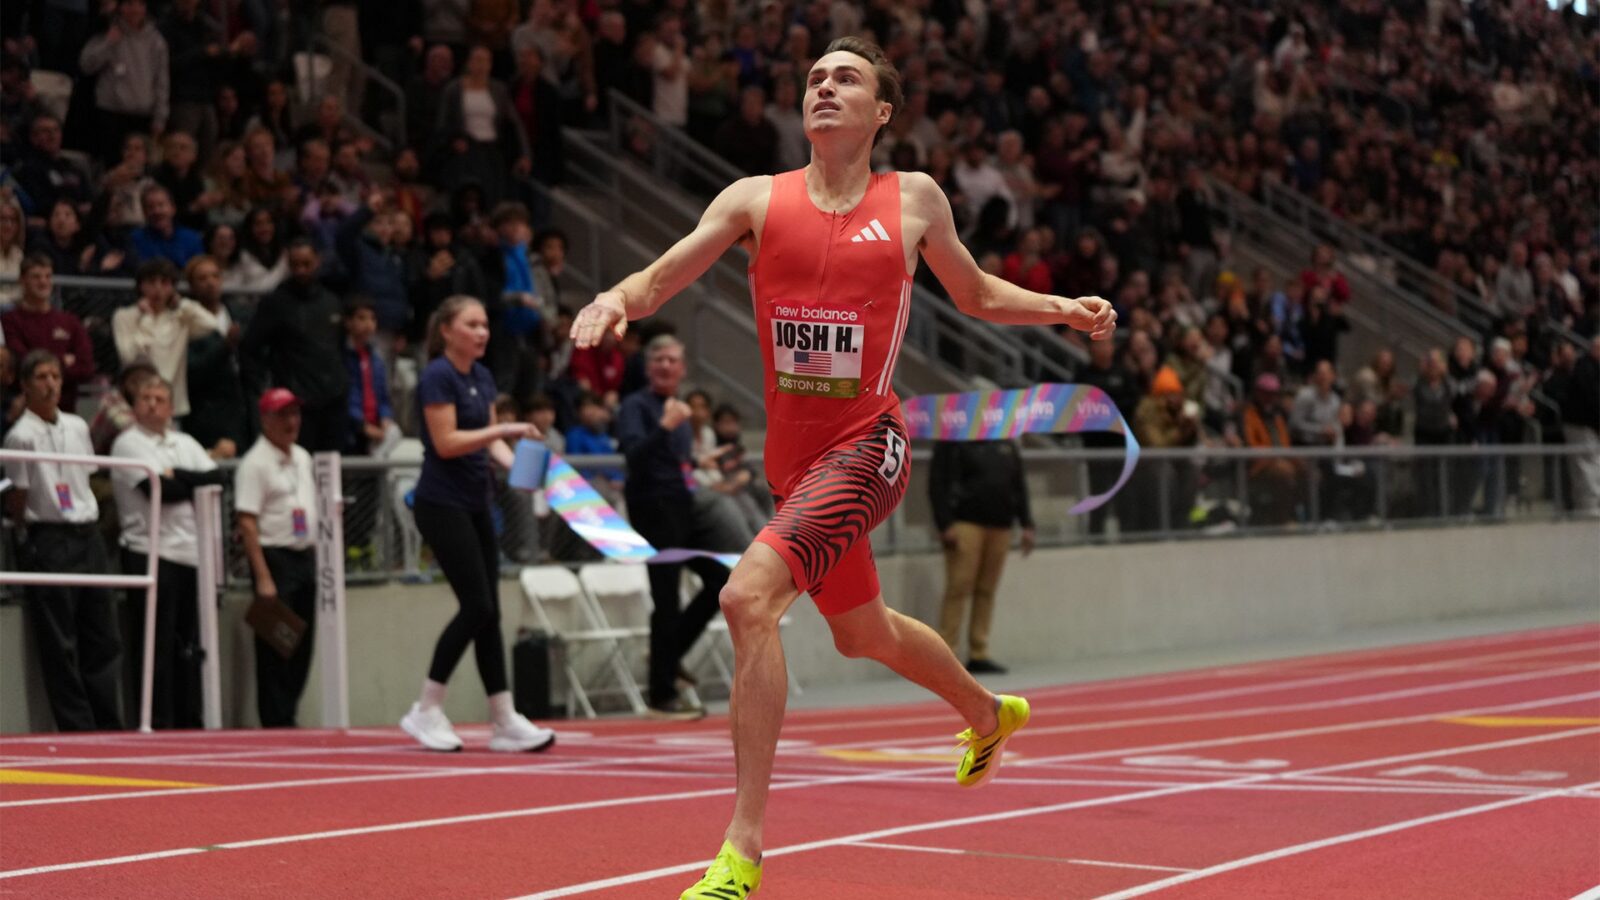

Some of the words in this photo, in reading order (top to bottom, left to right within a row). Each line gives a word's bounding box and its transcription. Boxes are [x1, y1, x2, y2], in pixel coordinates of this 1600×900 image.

[775, 306, 799, 317] new
[801, 306, 858, 321] balance
[776, 322, 829, 351] JOSH
[835, 327, 858, 353] H.
[779, 376, 814, 391] BOSTON
[816, 382, 831, 392] 26
[884, 436, 901, 479] 5
[318, 474, 336, 612] FINISH
